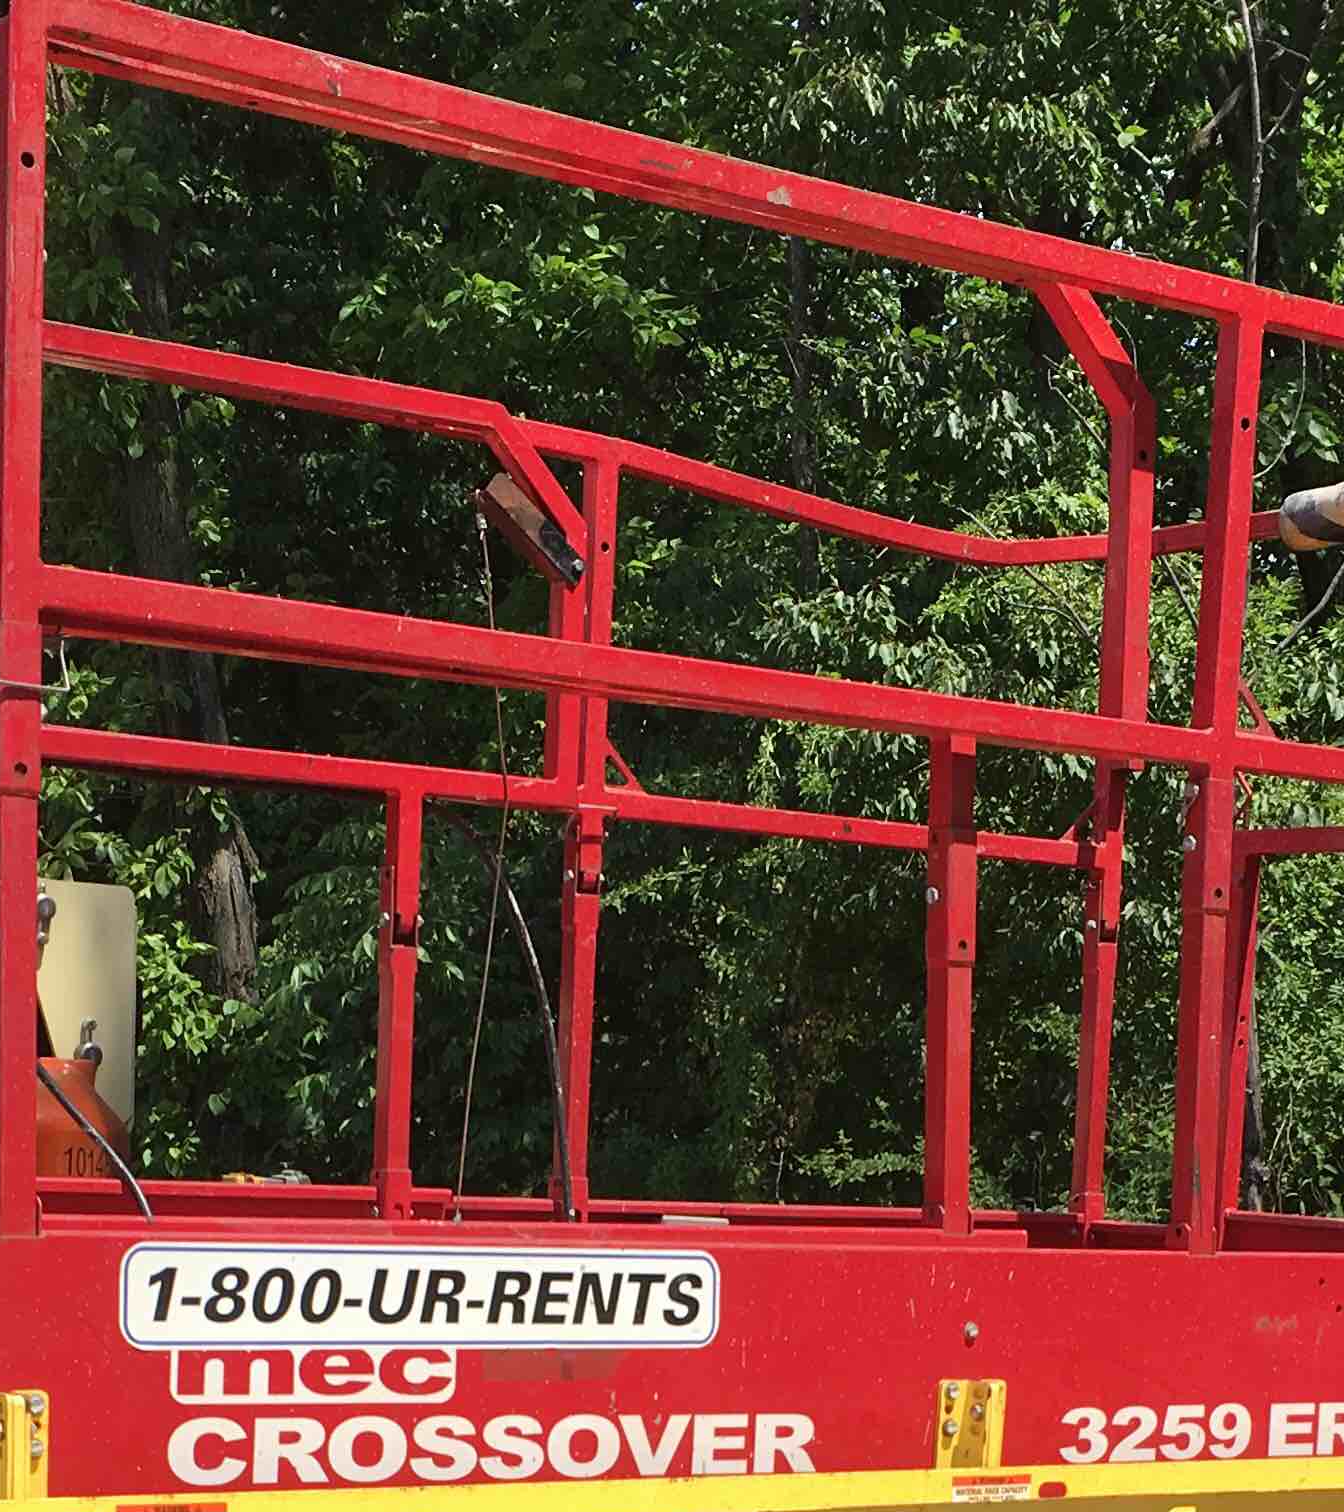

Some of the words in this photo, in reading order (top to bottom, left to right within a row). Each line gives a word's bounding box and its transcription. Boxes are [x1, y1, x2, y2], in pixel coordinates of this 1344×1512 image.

[146, 1266, 703, 1327] 1-800-UR-RENTS
[167, 1413, 817, 1486] CROSSOVER
[1059, 1403, 1253, 1464] 3259
